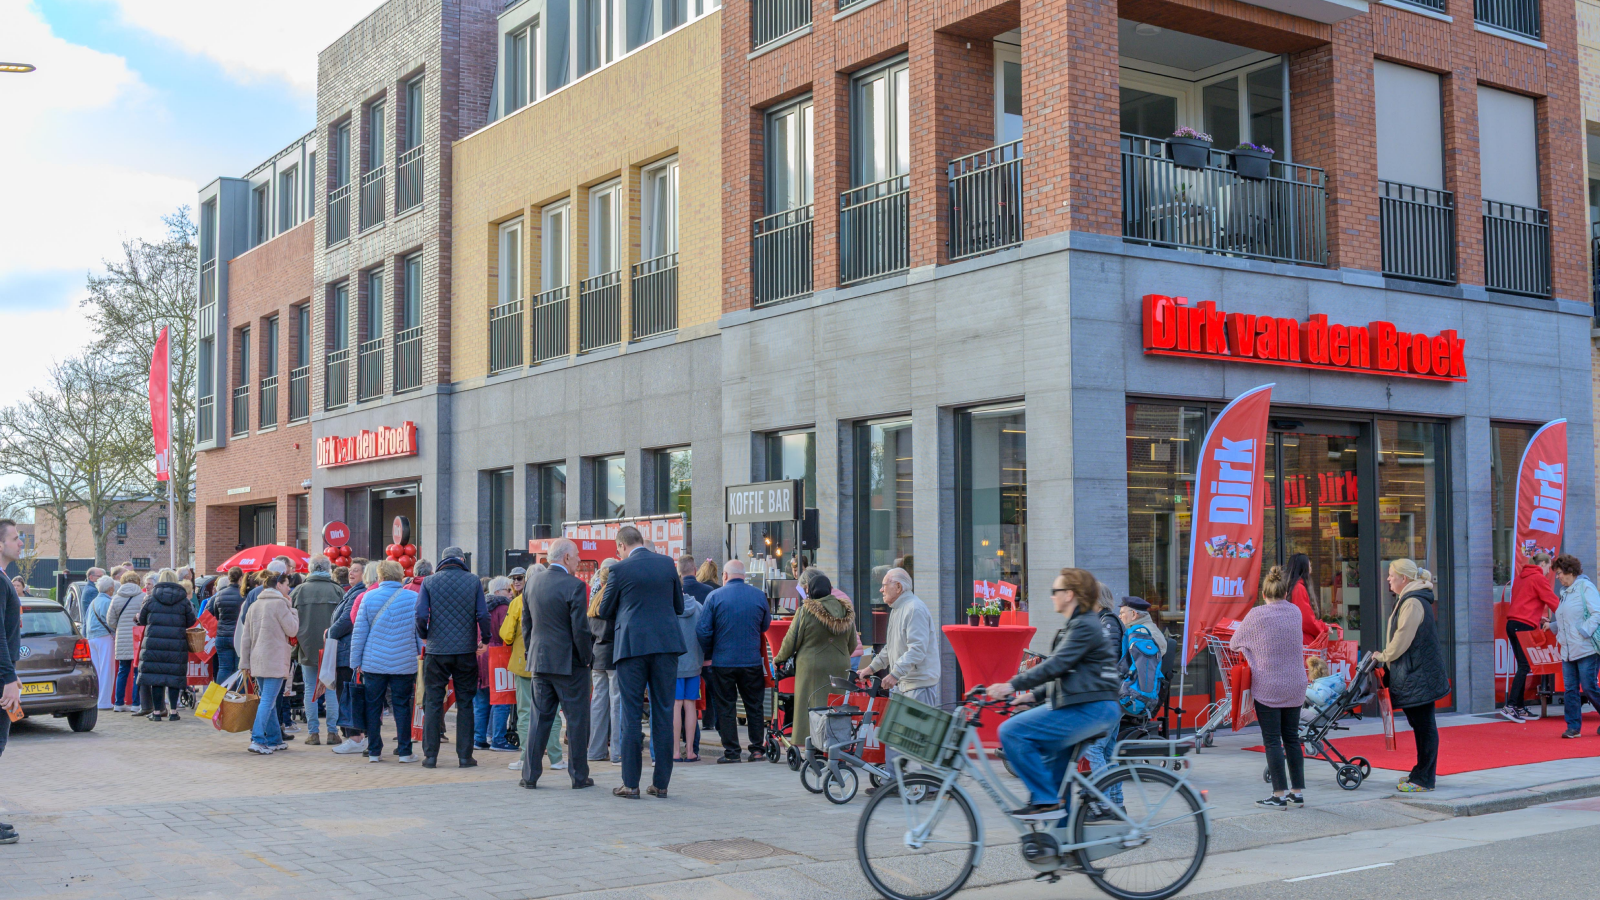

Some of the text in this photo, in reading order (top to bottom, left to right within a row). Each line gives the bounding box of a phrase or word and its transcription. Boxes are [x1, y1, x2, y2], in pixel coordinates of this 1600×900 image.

[1143, 294, 1467, 377] Dirk van den Broek
[317, 421, 411, 466] Dirk van den Broek
[1209, 436, 1253, 525] Dirk
[730, 489, 790, 515] KOFFIE BAR
[1529, 460, 1562, 534] Dirk
[330, 530, 344, 539] Dirk
[670, 522, 682, 537] Dirk
[582, 541, 597, 550] Dirk
[999, 585, 1013, 597] Dirk
[1212, 576, 1245, 595] Dirk
[1526, 644, 1562, 664] Dirk
[22, 684, 50, 693] -XPL-4
